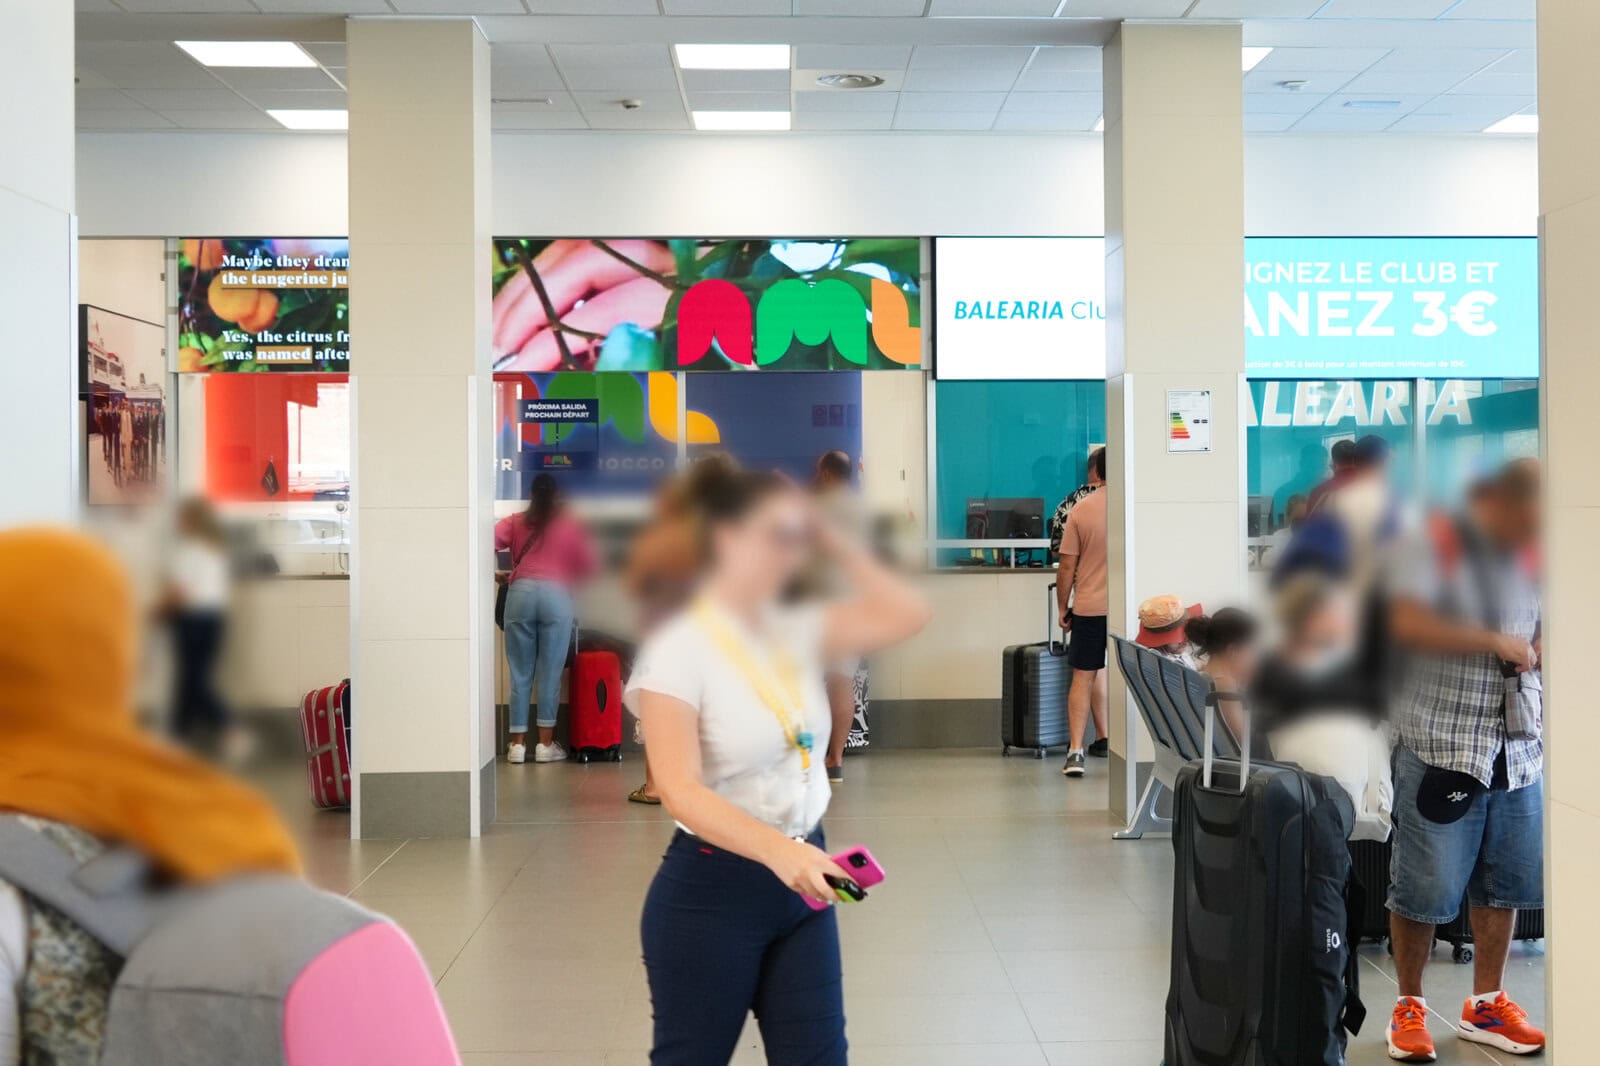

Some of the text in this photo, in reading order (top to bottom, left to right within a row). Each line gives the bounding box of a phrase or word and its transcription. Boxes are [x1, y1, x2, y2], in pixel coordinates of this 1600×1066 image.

[221, 255, 272, 270] Maybe
[276, 255, 310, 270] they
[221, 272, 348, 288] the tangerine ju
[1244, 261, 1499, 284] IGNEZ LE CLUB ET
[1411, 290, 1499, 337] 3€
[222, 330, 253, 343] Yes,
[256, 330, 283, 343] the
[286, 330, 333, 343] citrus
[222, 350, 253, 360] was
[256, 347, 311, 360] named
